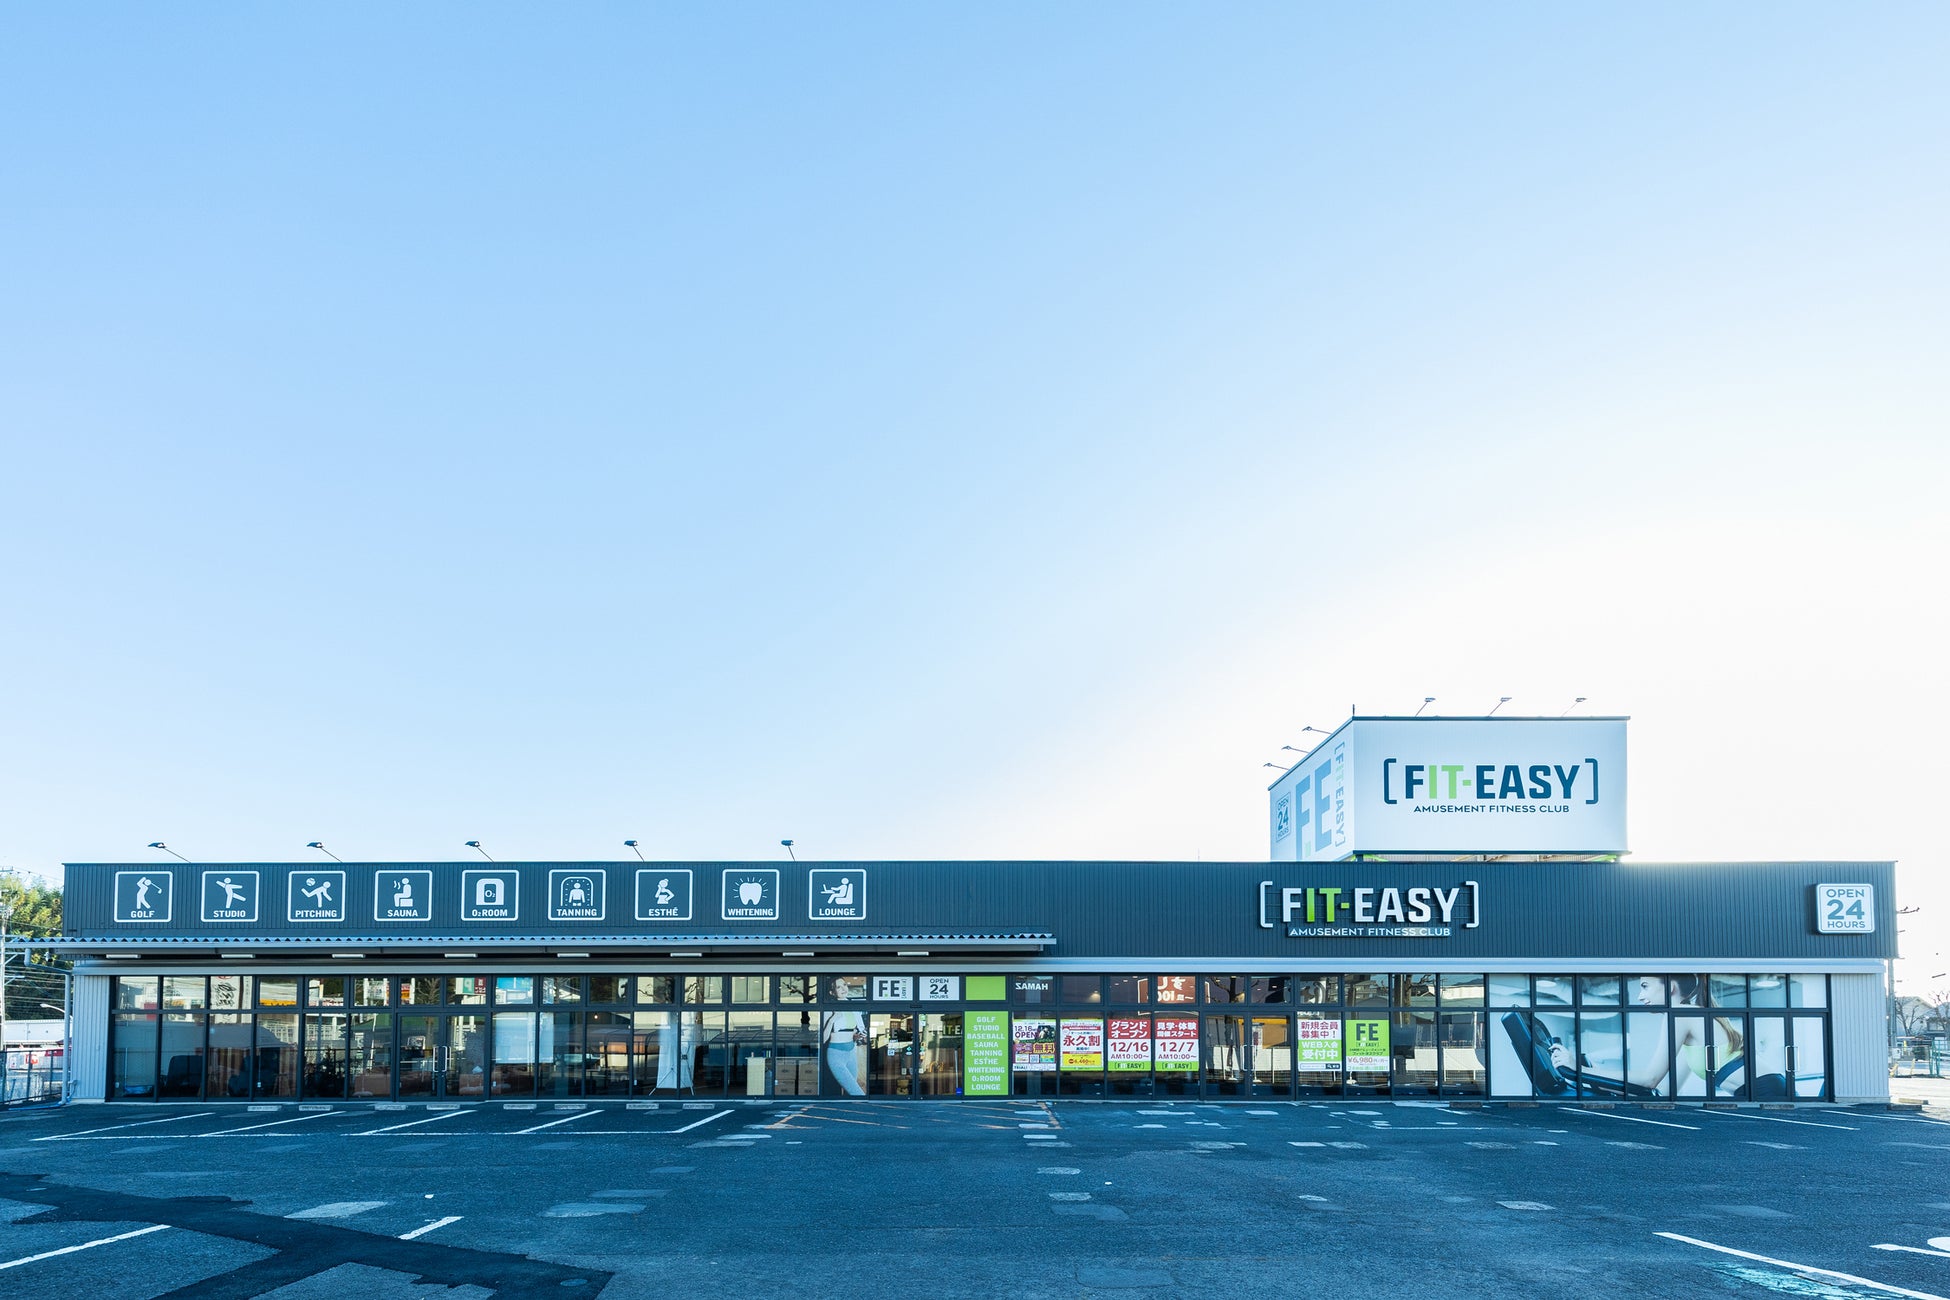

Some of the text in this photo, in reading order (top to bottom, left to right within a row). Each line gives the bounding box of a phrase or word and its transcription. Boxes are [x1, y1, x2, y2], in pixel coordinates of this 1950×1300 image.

[1413, 805, 1570, 813] AMUSEMENT FITNESS CLUB
[1277, 806, 1289, 831] 24
[1826, 888, 1865, 898] OPEN
[213, 909, 246, 919] STUDIO
[295, 909, 338, 919] PITCHING
[387, 909, 418, 918] SAUNA
[556, 908, 598, 917] TANNING
[648, 906, 679, 917] ESTHÉ
[727, 908, 774, 917] WHITENING
[819, 908, 856, 916] LOUNGE
[1826, 899, 1866, 920] 24
[130, 910, 155, 919] GOLF
[1827, 920, 1866, 929] HOURS
[1289, 928, 1451, 937] AMUSEMENT FITNESS CLUB
[929, 984, 949, 995] 24
[1111, 1021, 1148, 1030] グランド
[1301, 1021, 1338, 1030] 新規会員
[1111, 1030, 1148, 1039] オープン
[1063, 1035, 1101, 1047] 永久割
[1110, 1041, 1149, 1052] 12/16
[1160, 1041, 1195, 1052] 12/7
[1302, 1049, 1338, 1060] 受付中
